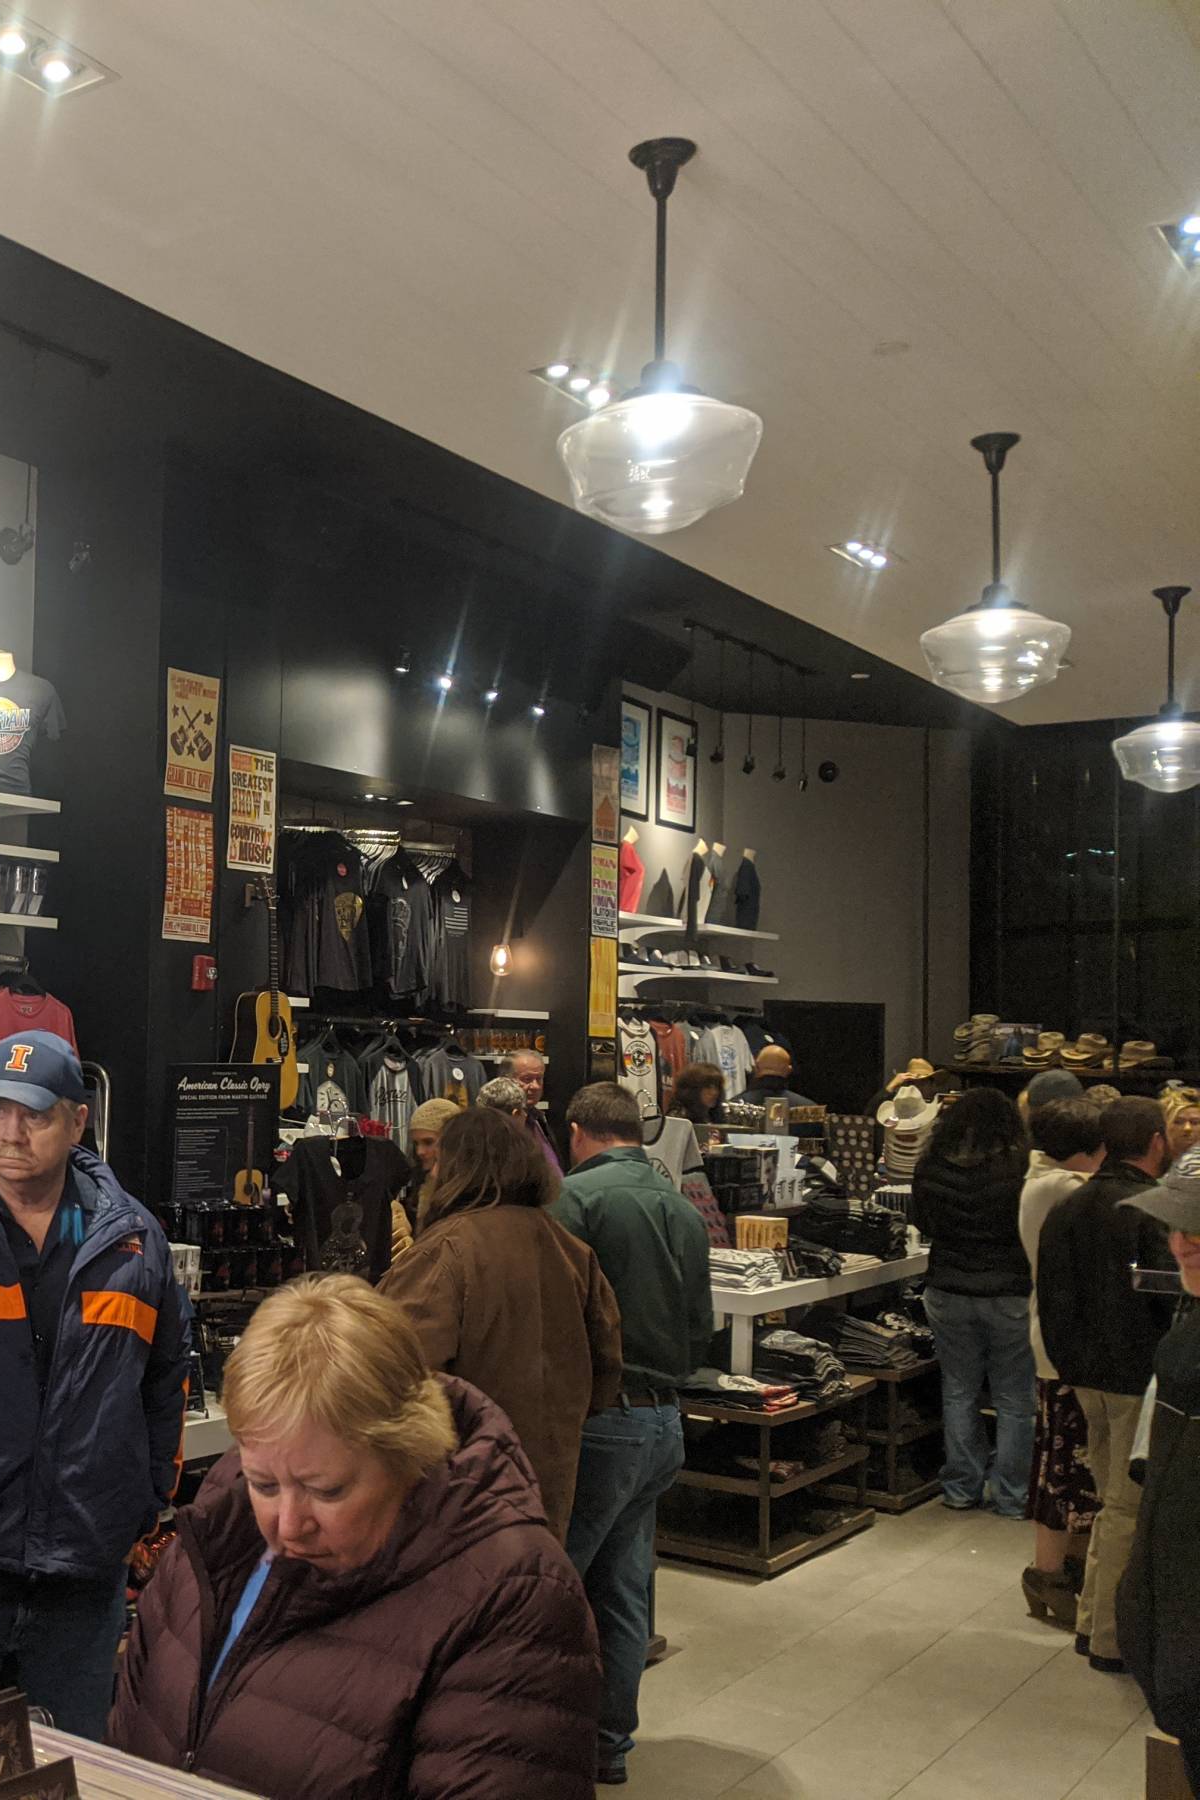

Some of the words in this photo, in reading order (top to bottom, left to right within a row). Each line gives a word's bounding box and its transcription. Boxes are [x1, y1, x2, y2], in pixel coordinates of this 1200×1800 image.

[255, 757, 275, 773] THE
[231, 771, 274, 792] GREATEST
[231, 823, 272, 846] COUNTRY
[238, 841, 273, 866] MUSIC
[5, 1044, 34, 1072] I
[177, 1076, 218, 1091] American
[220, 1077, 248, 1090] Classic
[250, 1076, 271, 1093] Opry
